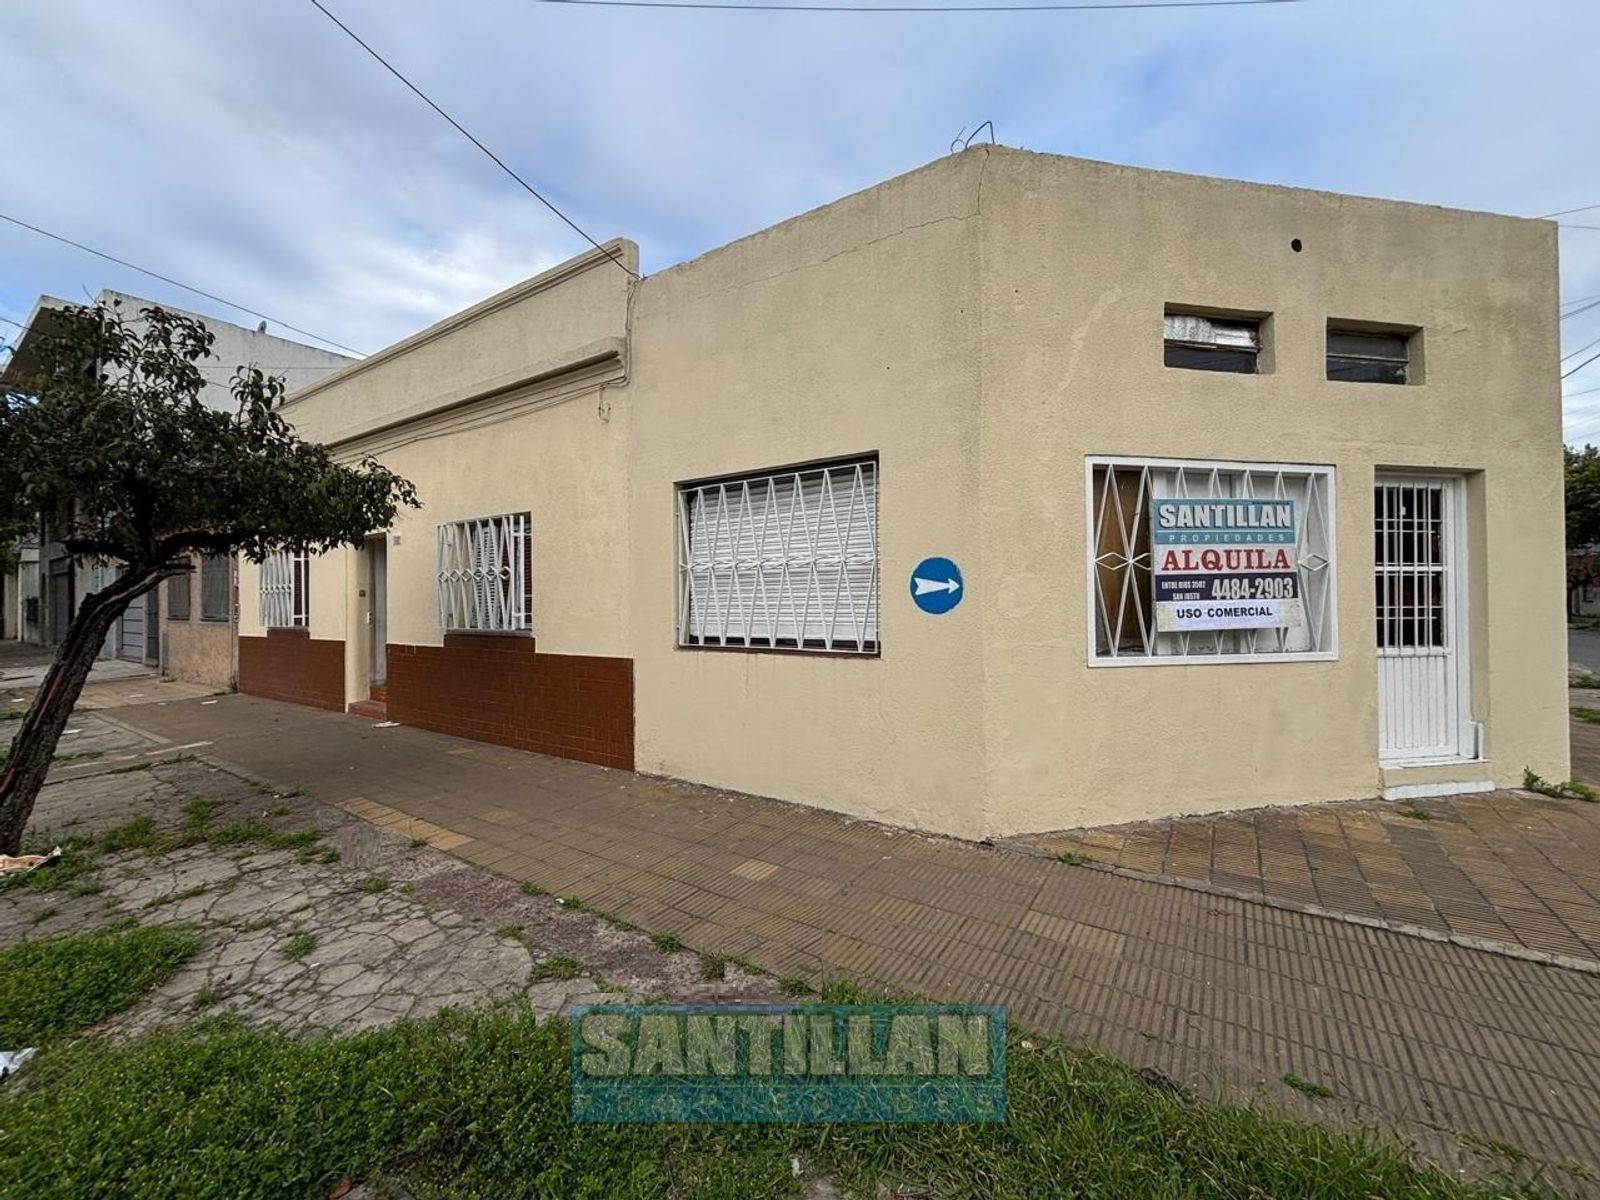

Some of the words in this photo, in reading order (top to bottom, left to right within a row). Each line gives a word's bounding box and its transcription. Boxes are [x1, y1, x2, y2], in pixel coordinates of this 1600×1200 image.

[1159, 504, 1292, 528] SANTILLAN
[1168, 534, 1285, 542] PROPIEDADES
[1161, 549, 1291, 571] ALQUILA
[1211, 577, 1294, 600] 4484-2903
[1176, 609, 1202, 618] USO
[1207, 607, 1273, 618] COMERCIAL
